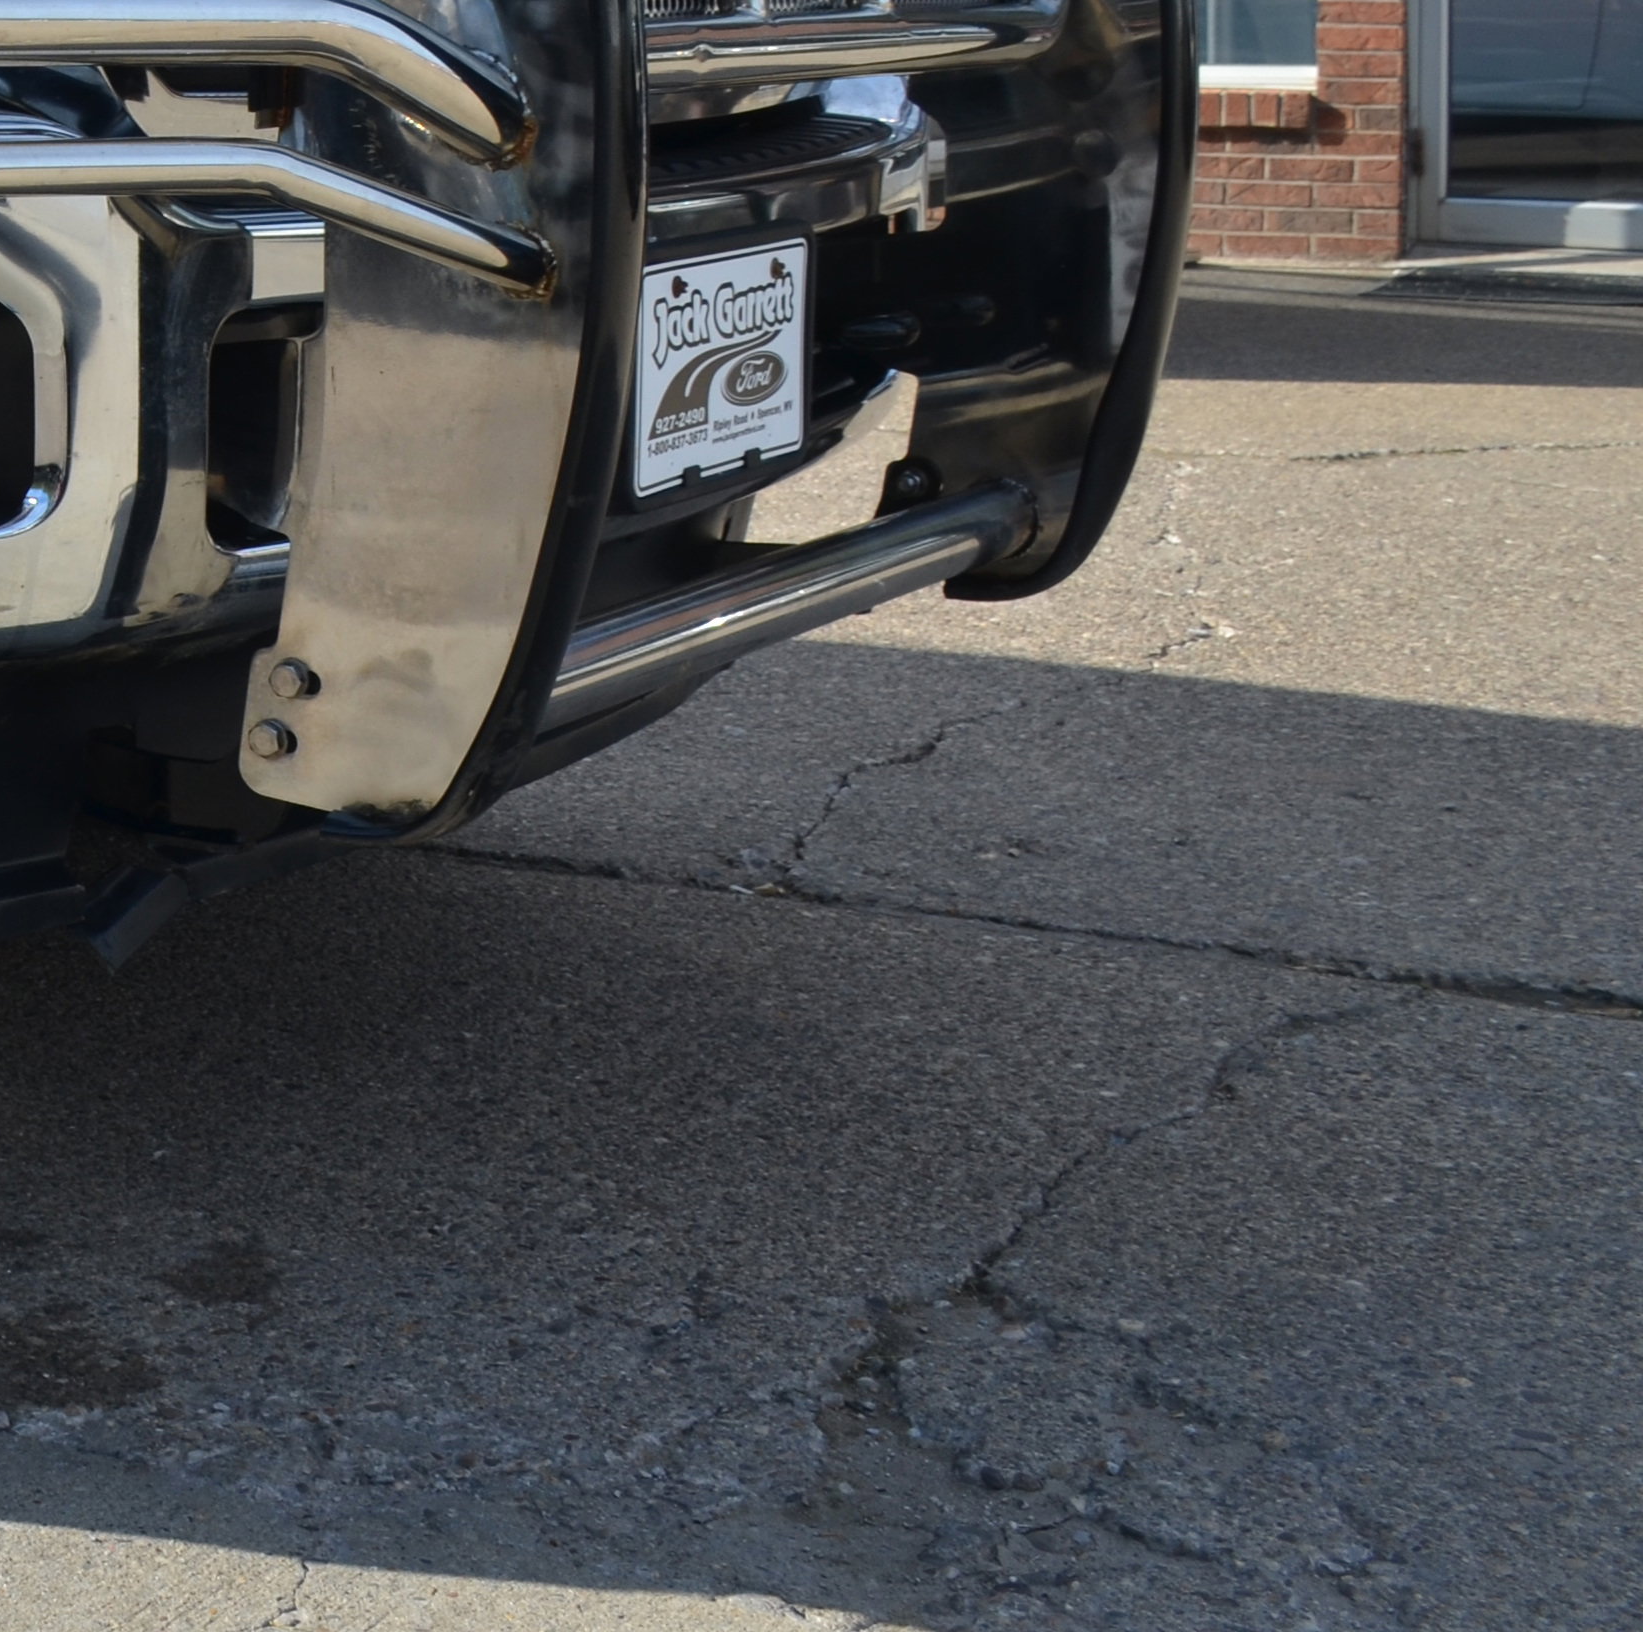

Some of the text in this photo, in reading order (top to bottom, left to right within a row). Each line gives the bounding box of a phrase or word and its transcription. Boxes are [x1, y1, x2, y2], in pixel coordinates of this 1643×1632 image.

[652, 272, 794, 369] Jack Garrett
[735, 358, 774, 394] Ford
[655, 406, 706, 434] 927-2490
